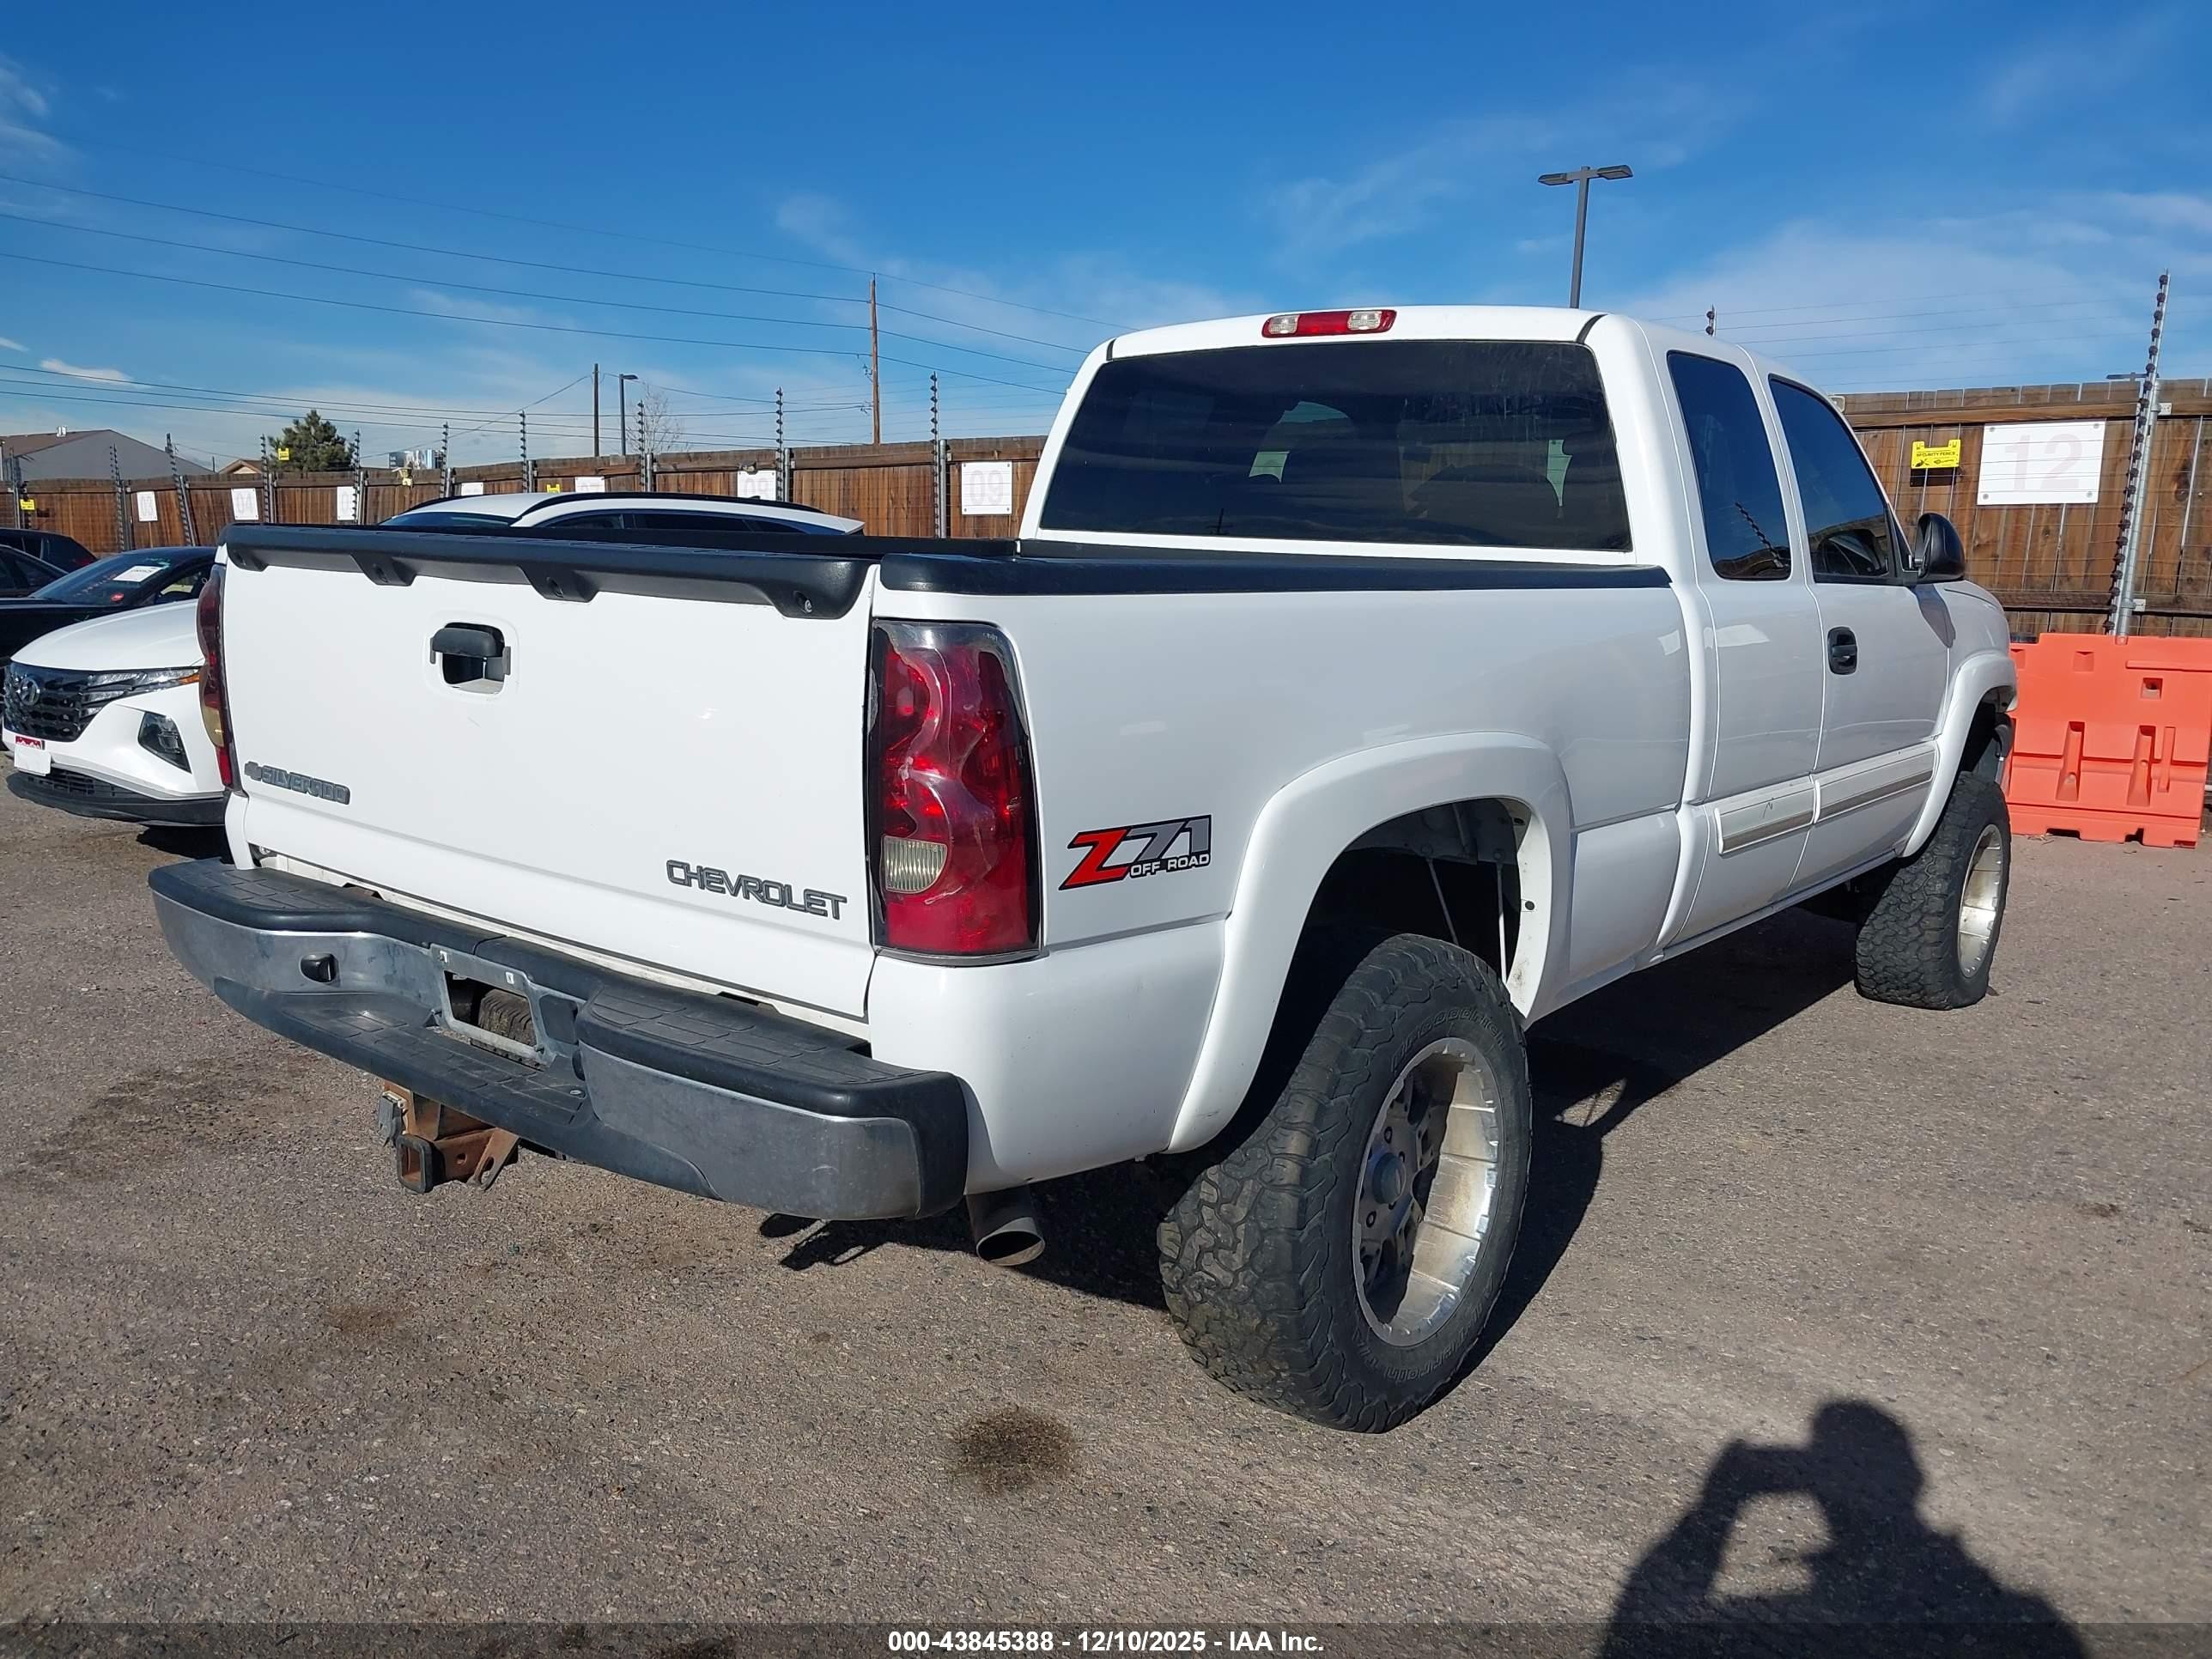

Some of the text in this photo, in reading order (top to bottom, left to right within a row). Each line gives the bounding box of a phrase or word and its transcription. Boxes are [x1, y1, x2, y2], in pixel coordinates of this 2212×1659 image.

[969, 469, 1004, 507] 09
[2005, 433, 2082, 493] 12
[261, 765, 350, 805] SILVERADO
[1058, 815, 1212, 890] Z71
[1129, 853, 1210, 878] OFF ROAD
[665, 860, 848, 921] CHEVROLET
